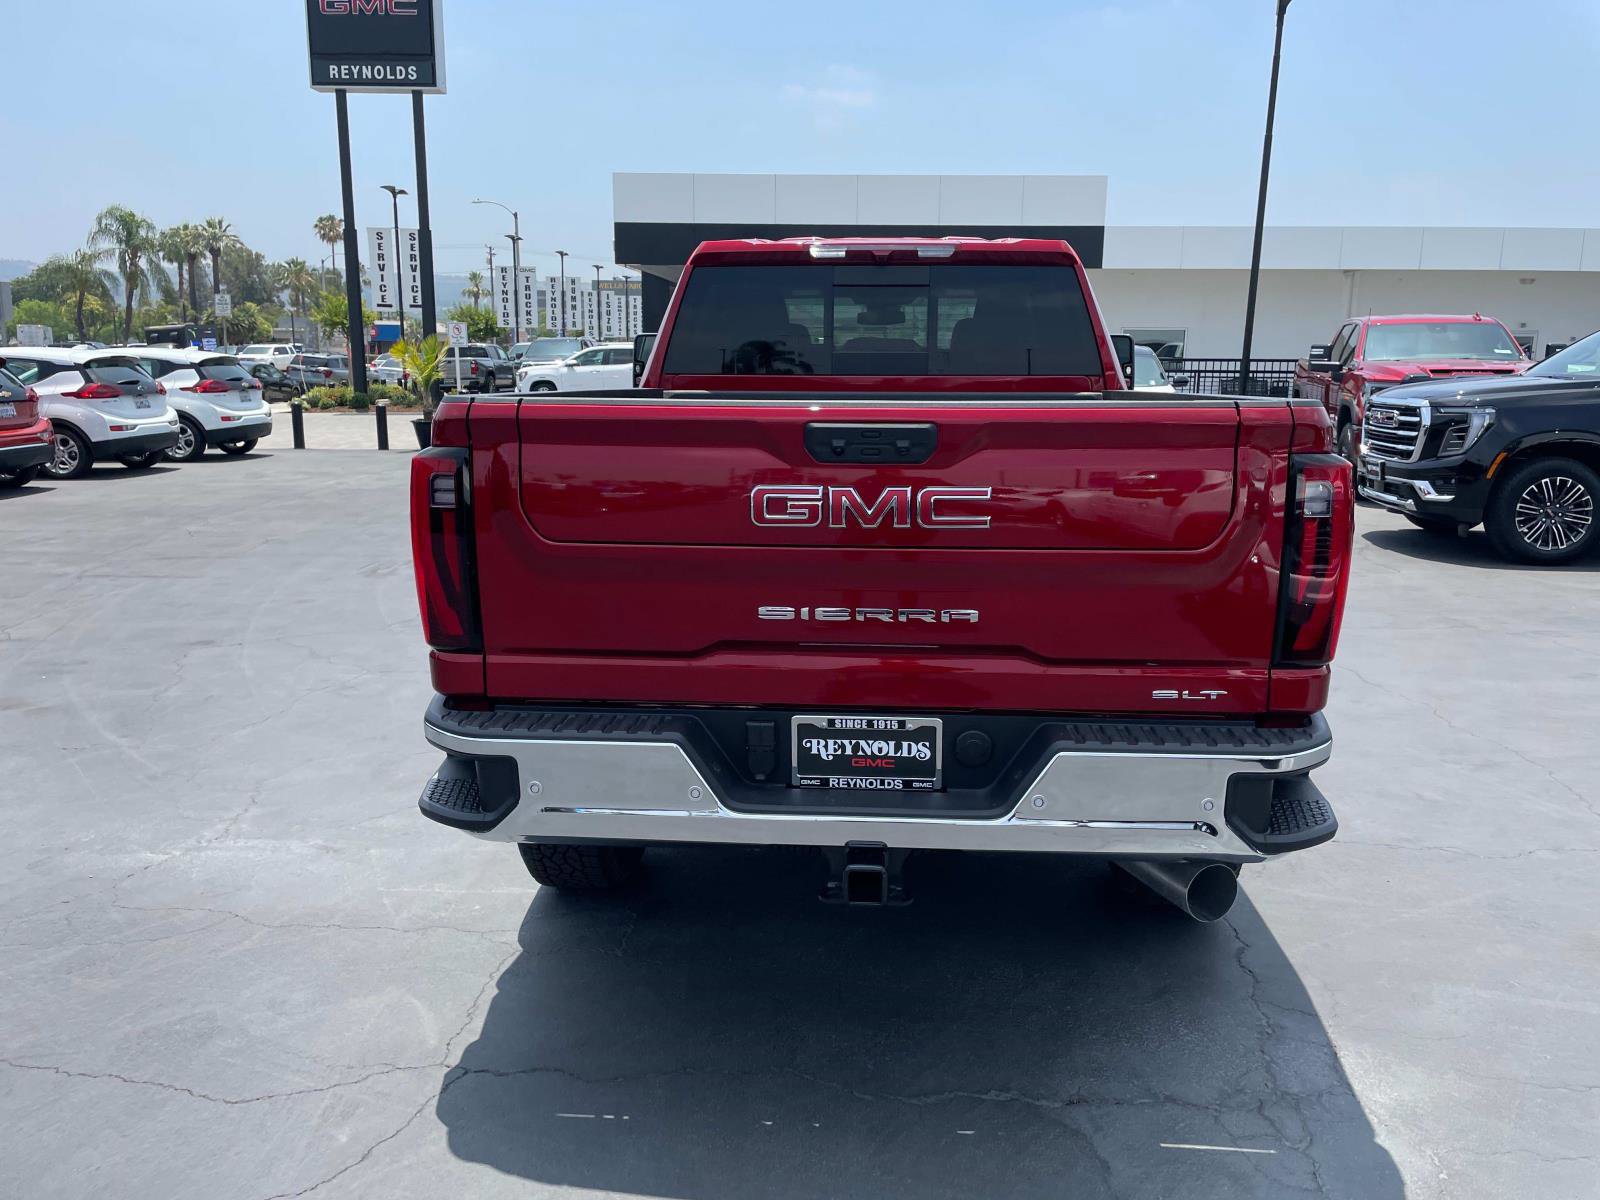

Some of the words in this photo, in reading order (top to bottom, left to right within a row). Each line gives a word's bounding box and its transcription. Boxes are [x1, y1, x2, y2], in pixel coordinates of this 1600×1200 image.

[319, 0, 418, 15] GMC
[329, 65, 418, 80] REYNOLDS
[376, 231, 387, 303] SERVICE
[408, 232, 419, 304] SERVICE
[501, 267, 510, 326] REYNOLDS
[524, 276, 532, 325] TRUCKS
[751, 485, 992, 528] GMC
[757, 606, 980, 623] SIERRA
[1151, 689, 1228, 700] SLT
[834, 719, 867, 729] SINCE
[872, 720, 899, 729] 1915
[802, 738, 932, 761] REYNOLDS
[851, 758, 896, 767] GMC
[829, 778, 903, 789] REYNOLDS
